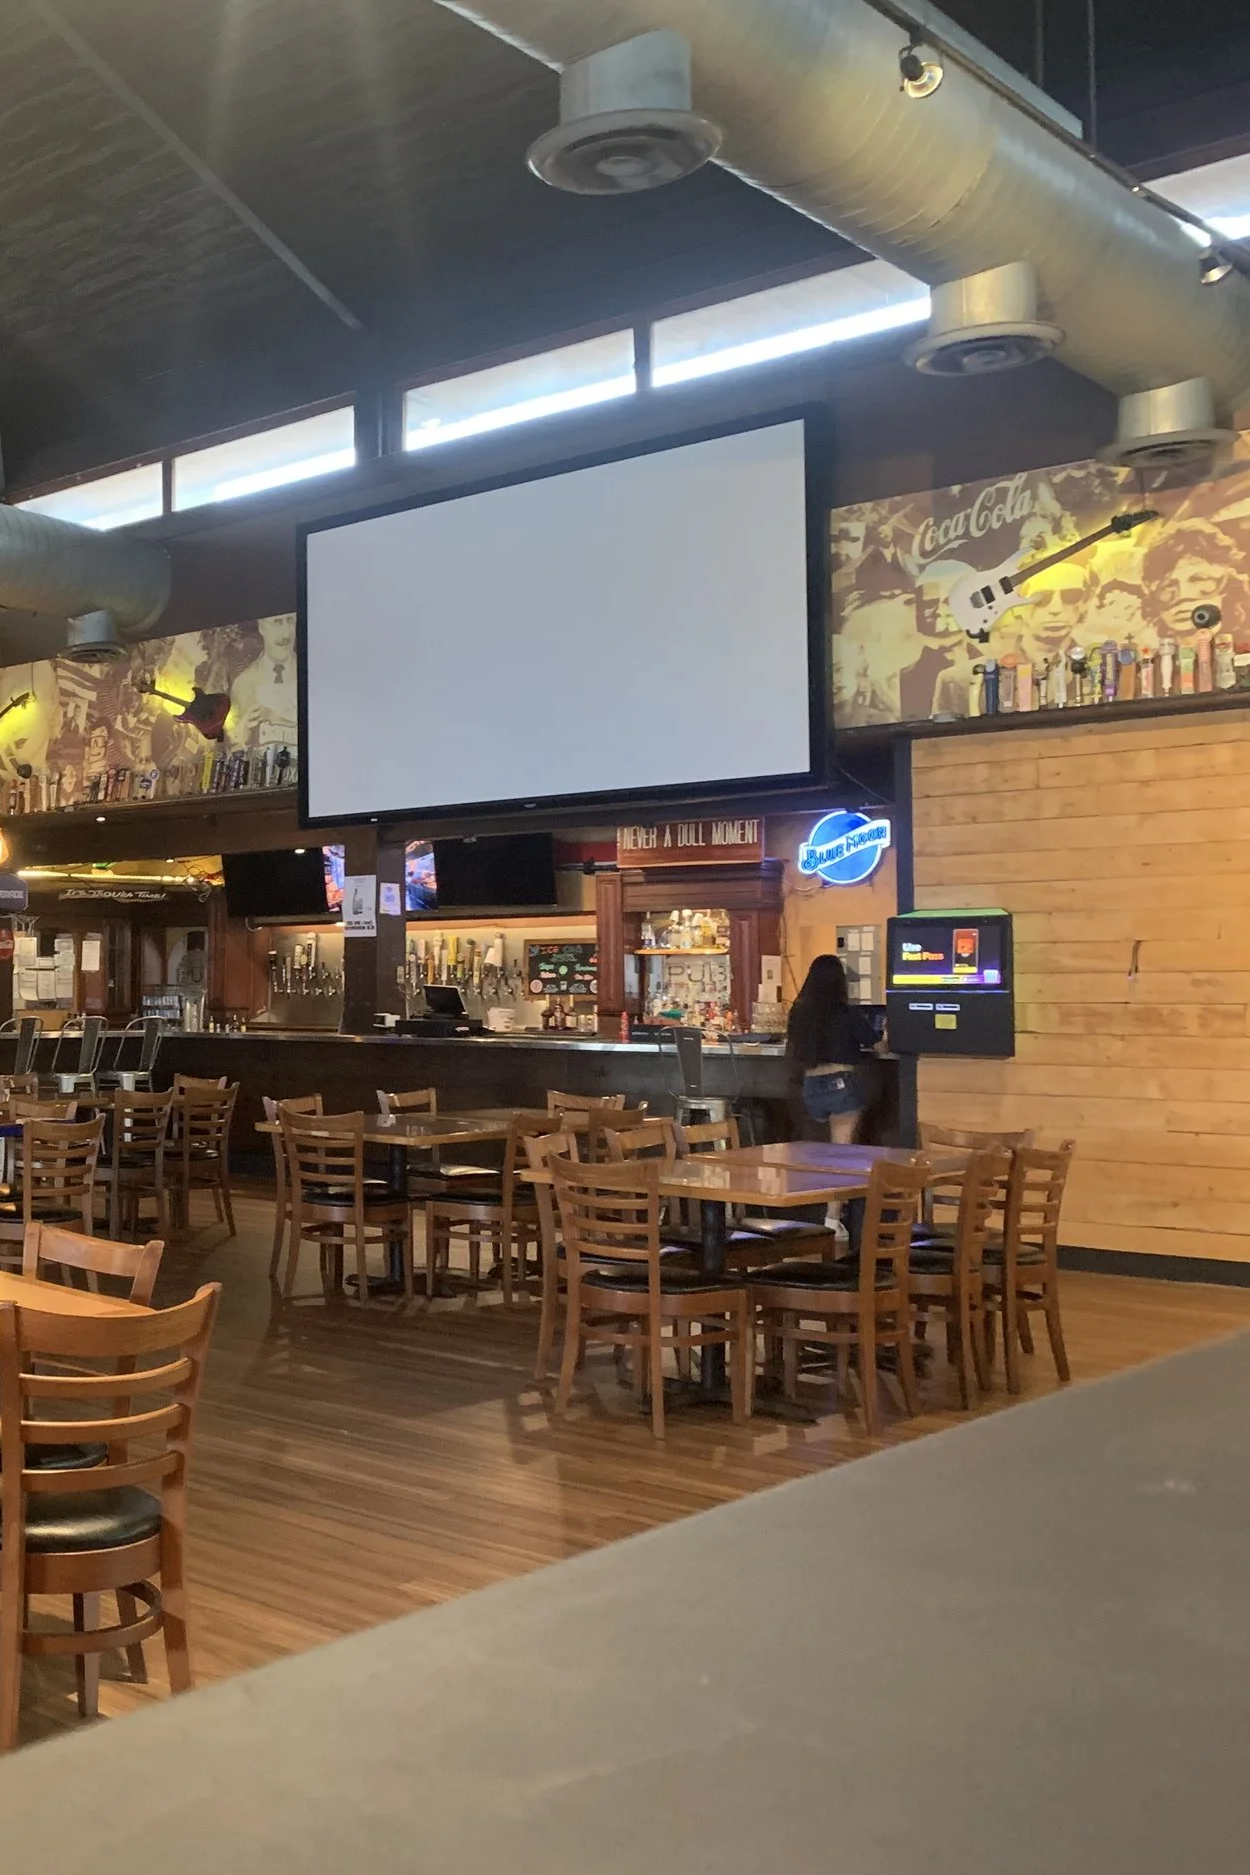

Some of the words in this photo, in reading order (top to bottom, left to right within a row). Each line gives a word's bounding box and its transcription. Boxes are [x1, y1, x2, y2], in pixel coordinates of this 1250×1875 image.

[623, 826, 657, 850] NEVER
[664, 824, 672, 848] A
[677, 822, 706, 847] DULL
[711, 819, 759, 846] MOMENT
